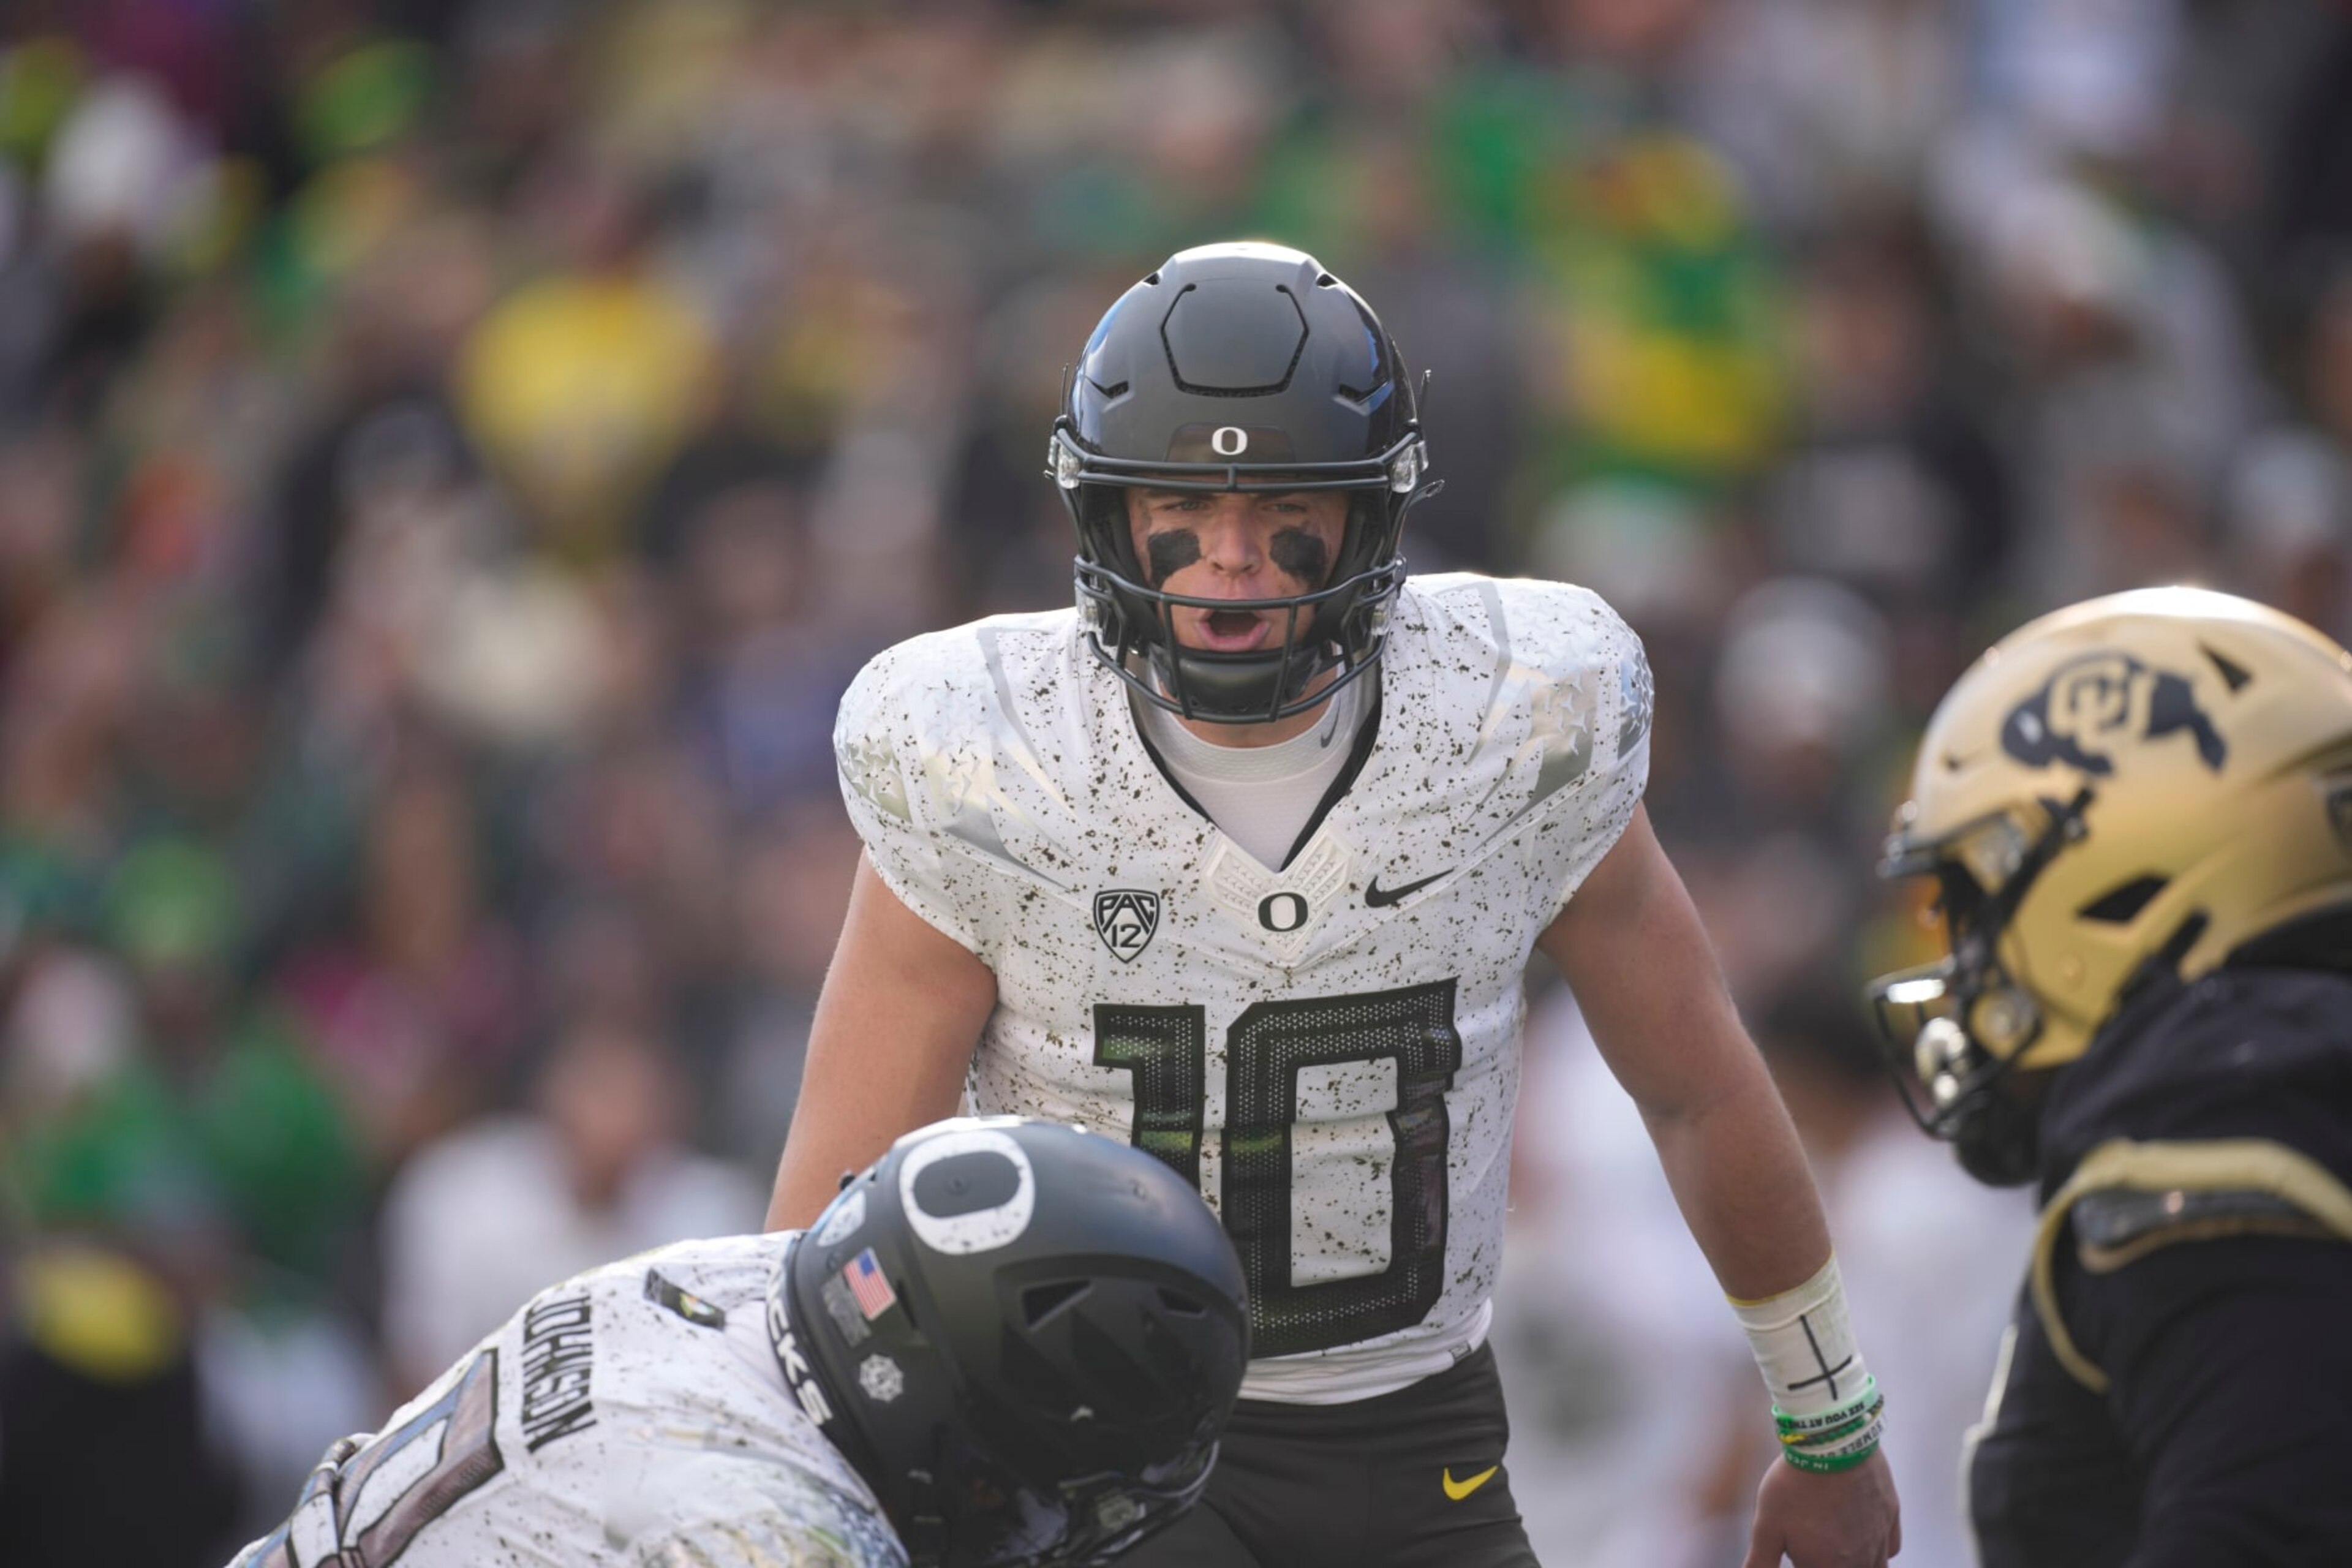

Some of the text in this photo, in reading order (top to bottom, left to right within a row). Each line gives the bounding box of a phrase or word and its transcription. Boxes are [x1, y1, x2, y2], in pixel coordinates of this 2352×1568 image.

[1212, 427, 1248, 455] O
[1098, 894, 1155, 934] PAC
[1258, 892, 1308, 932] O
[1112, 924, 1141, 948] 12
[1093, 978, 1461, 1360] 10
[899, 1129, 1035, 1255] O
[521, 1295, 597, 1455] JOHNSON
[1809, 1418, 1823, 1428] AT
[1825, 1411, 1848, 1426] YOU
